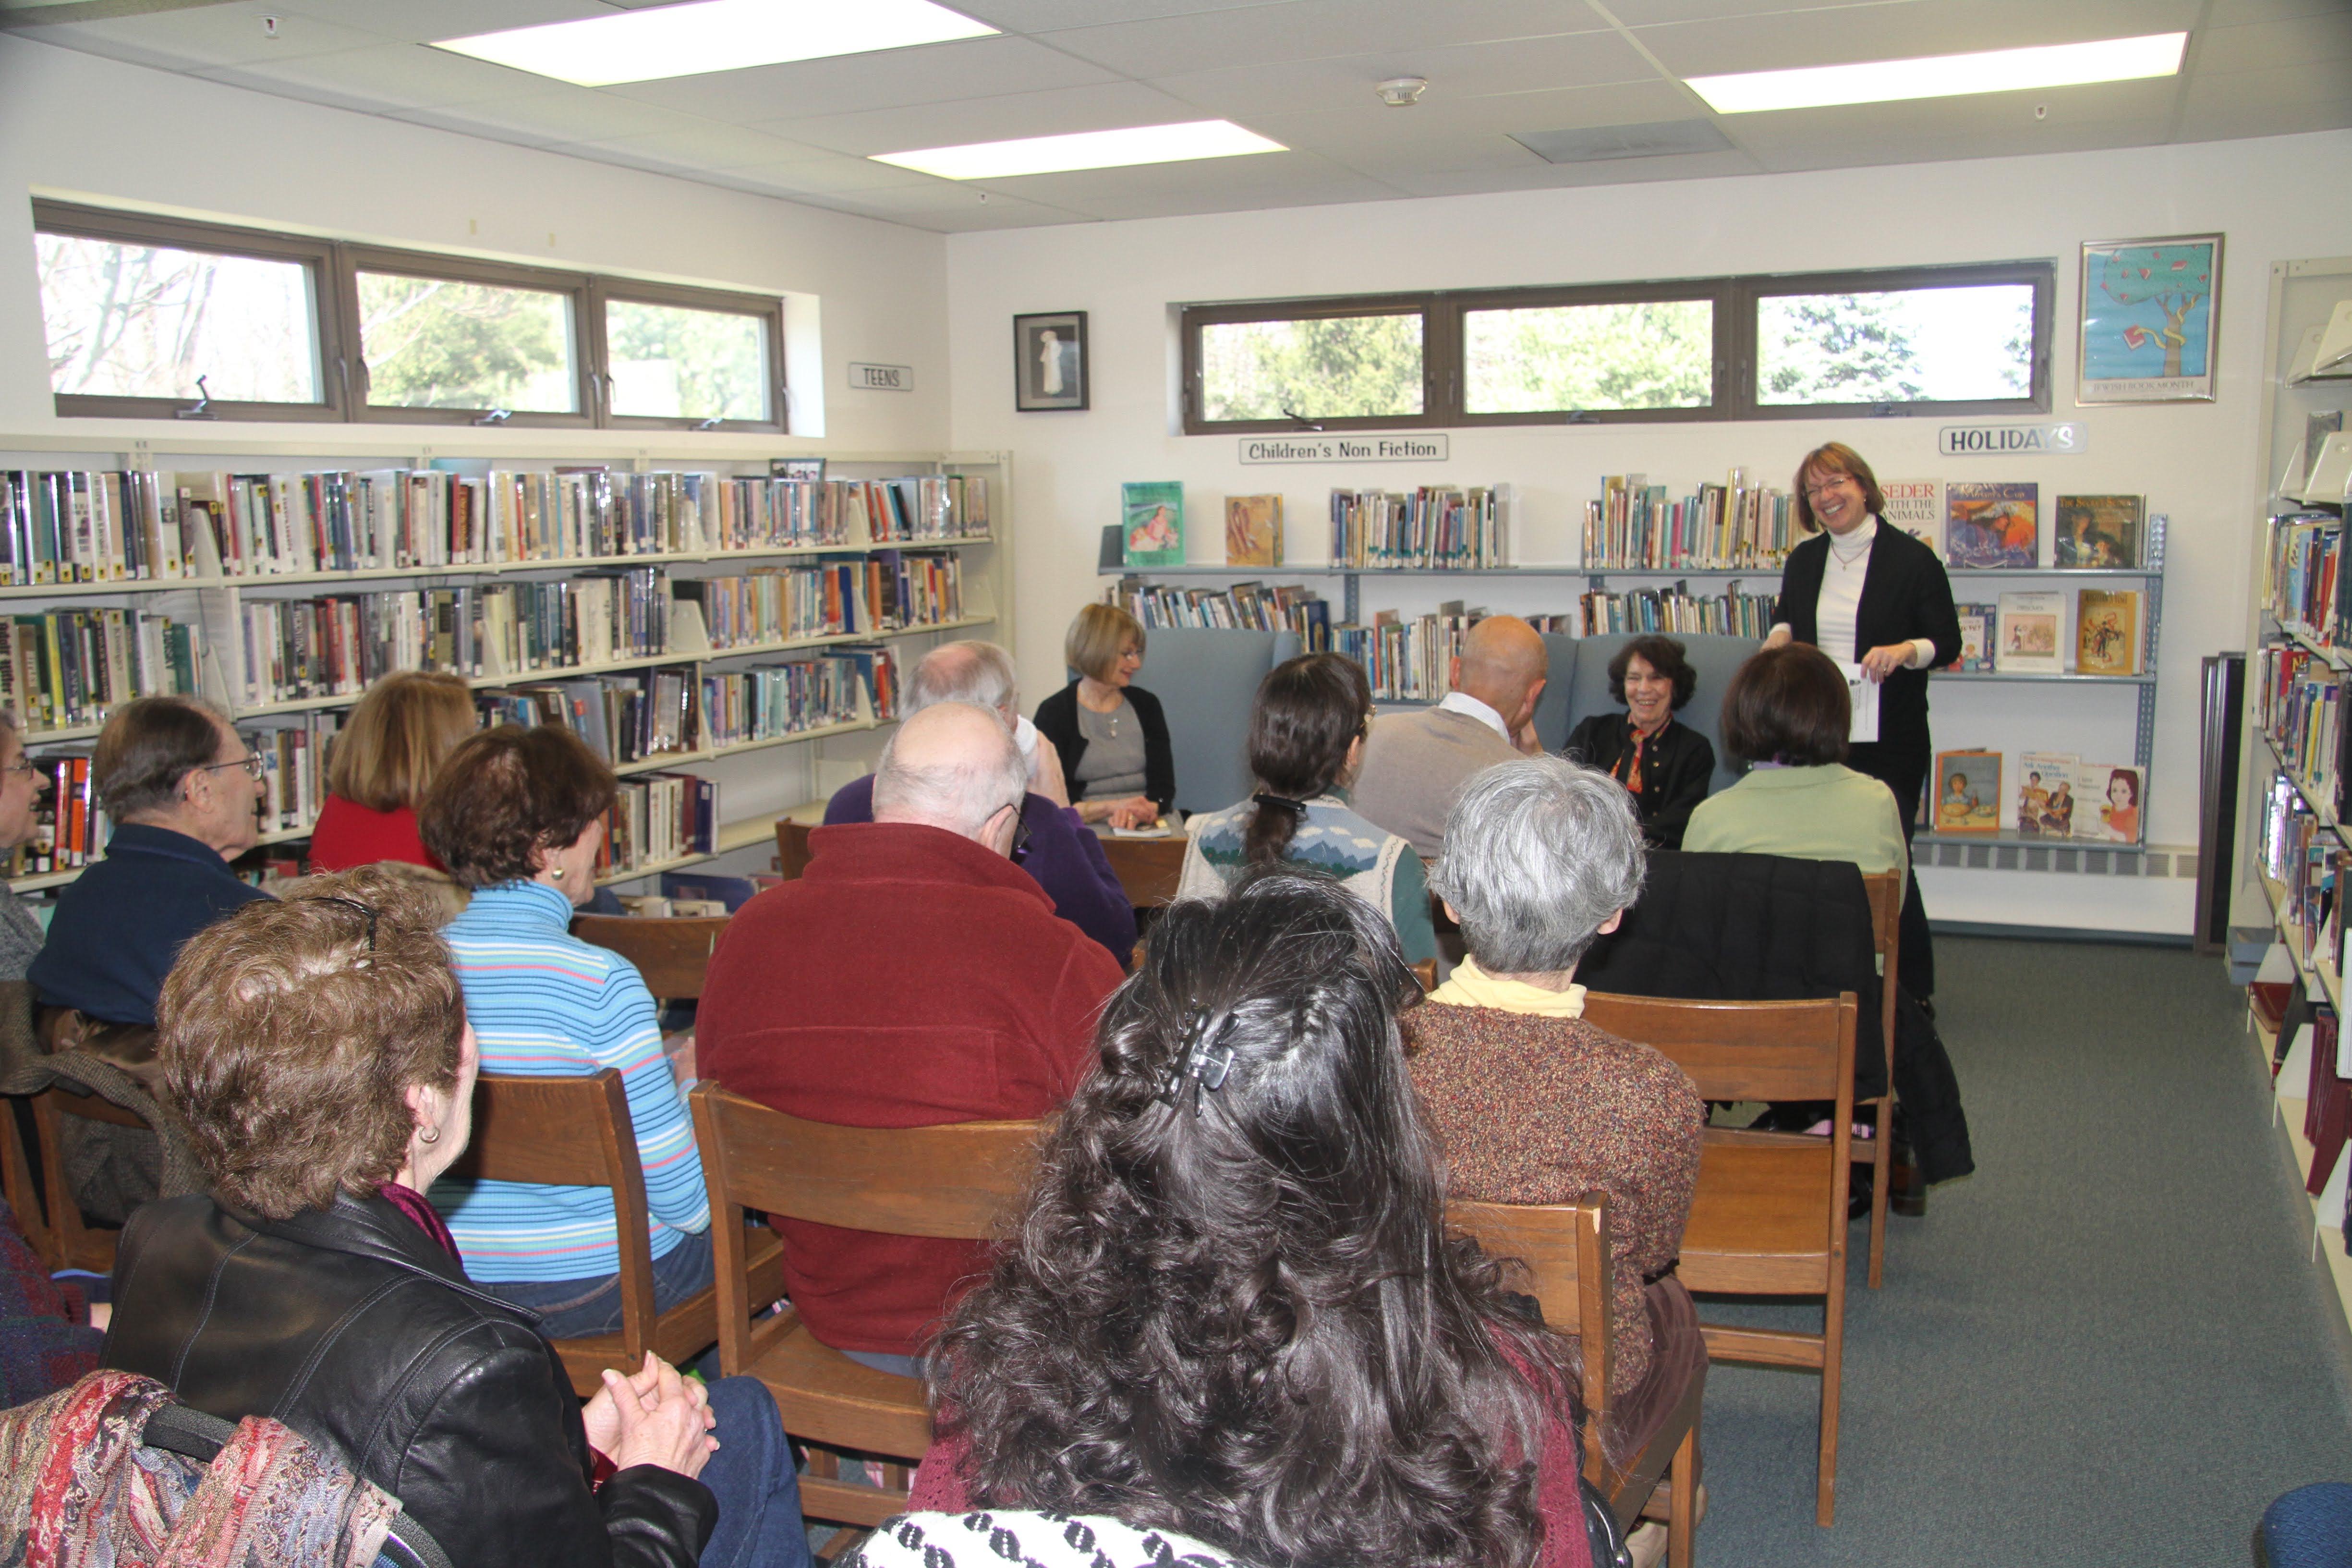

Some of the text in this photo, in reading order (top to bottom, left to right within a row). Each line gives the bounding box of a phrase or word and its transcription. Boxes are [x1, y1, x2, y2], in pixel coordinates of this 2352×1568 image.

[862, 368, 899, 387] TEENS
[2128, 382, 2155, 391] BOOK
[2156, 380, 2194, 389] MONTH
[1951, 426, 2074, 451] HOLIDAYS
[1249, 441, 1437, 459] Children's Non Fiction
[1880, 483, 1936, 498] SEDER
[1913, 499, 1936, 509] THE
[1881, 510, 1935, 520] ANIMALS
